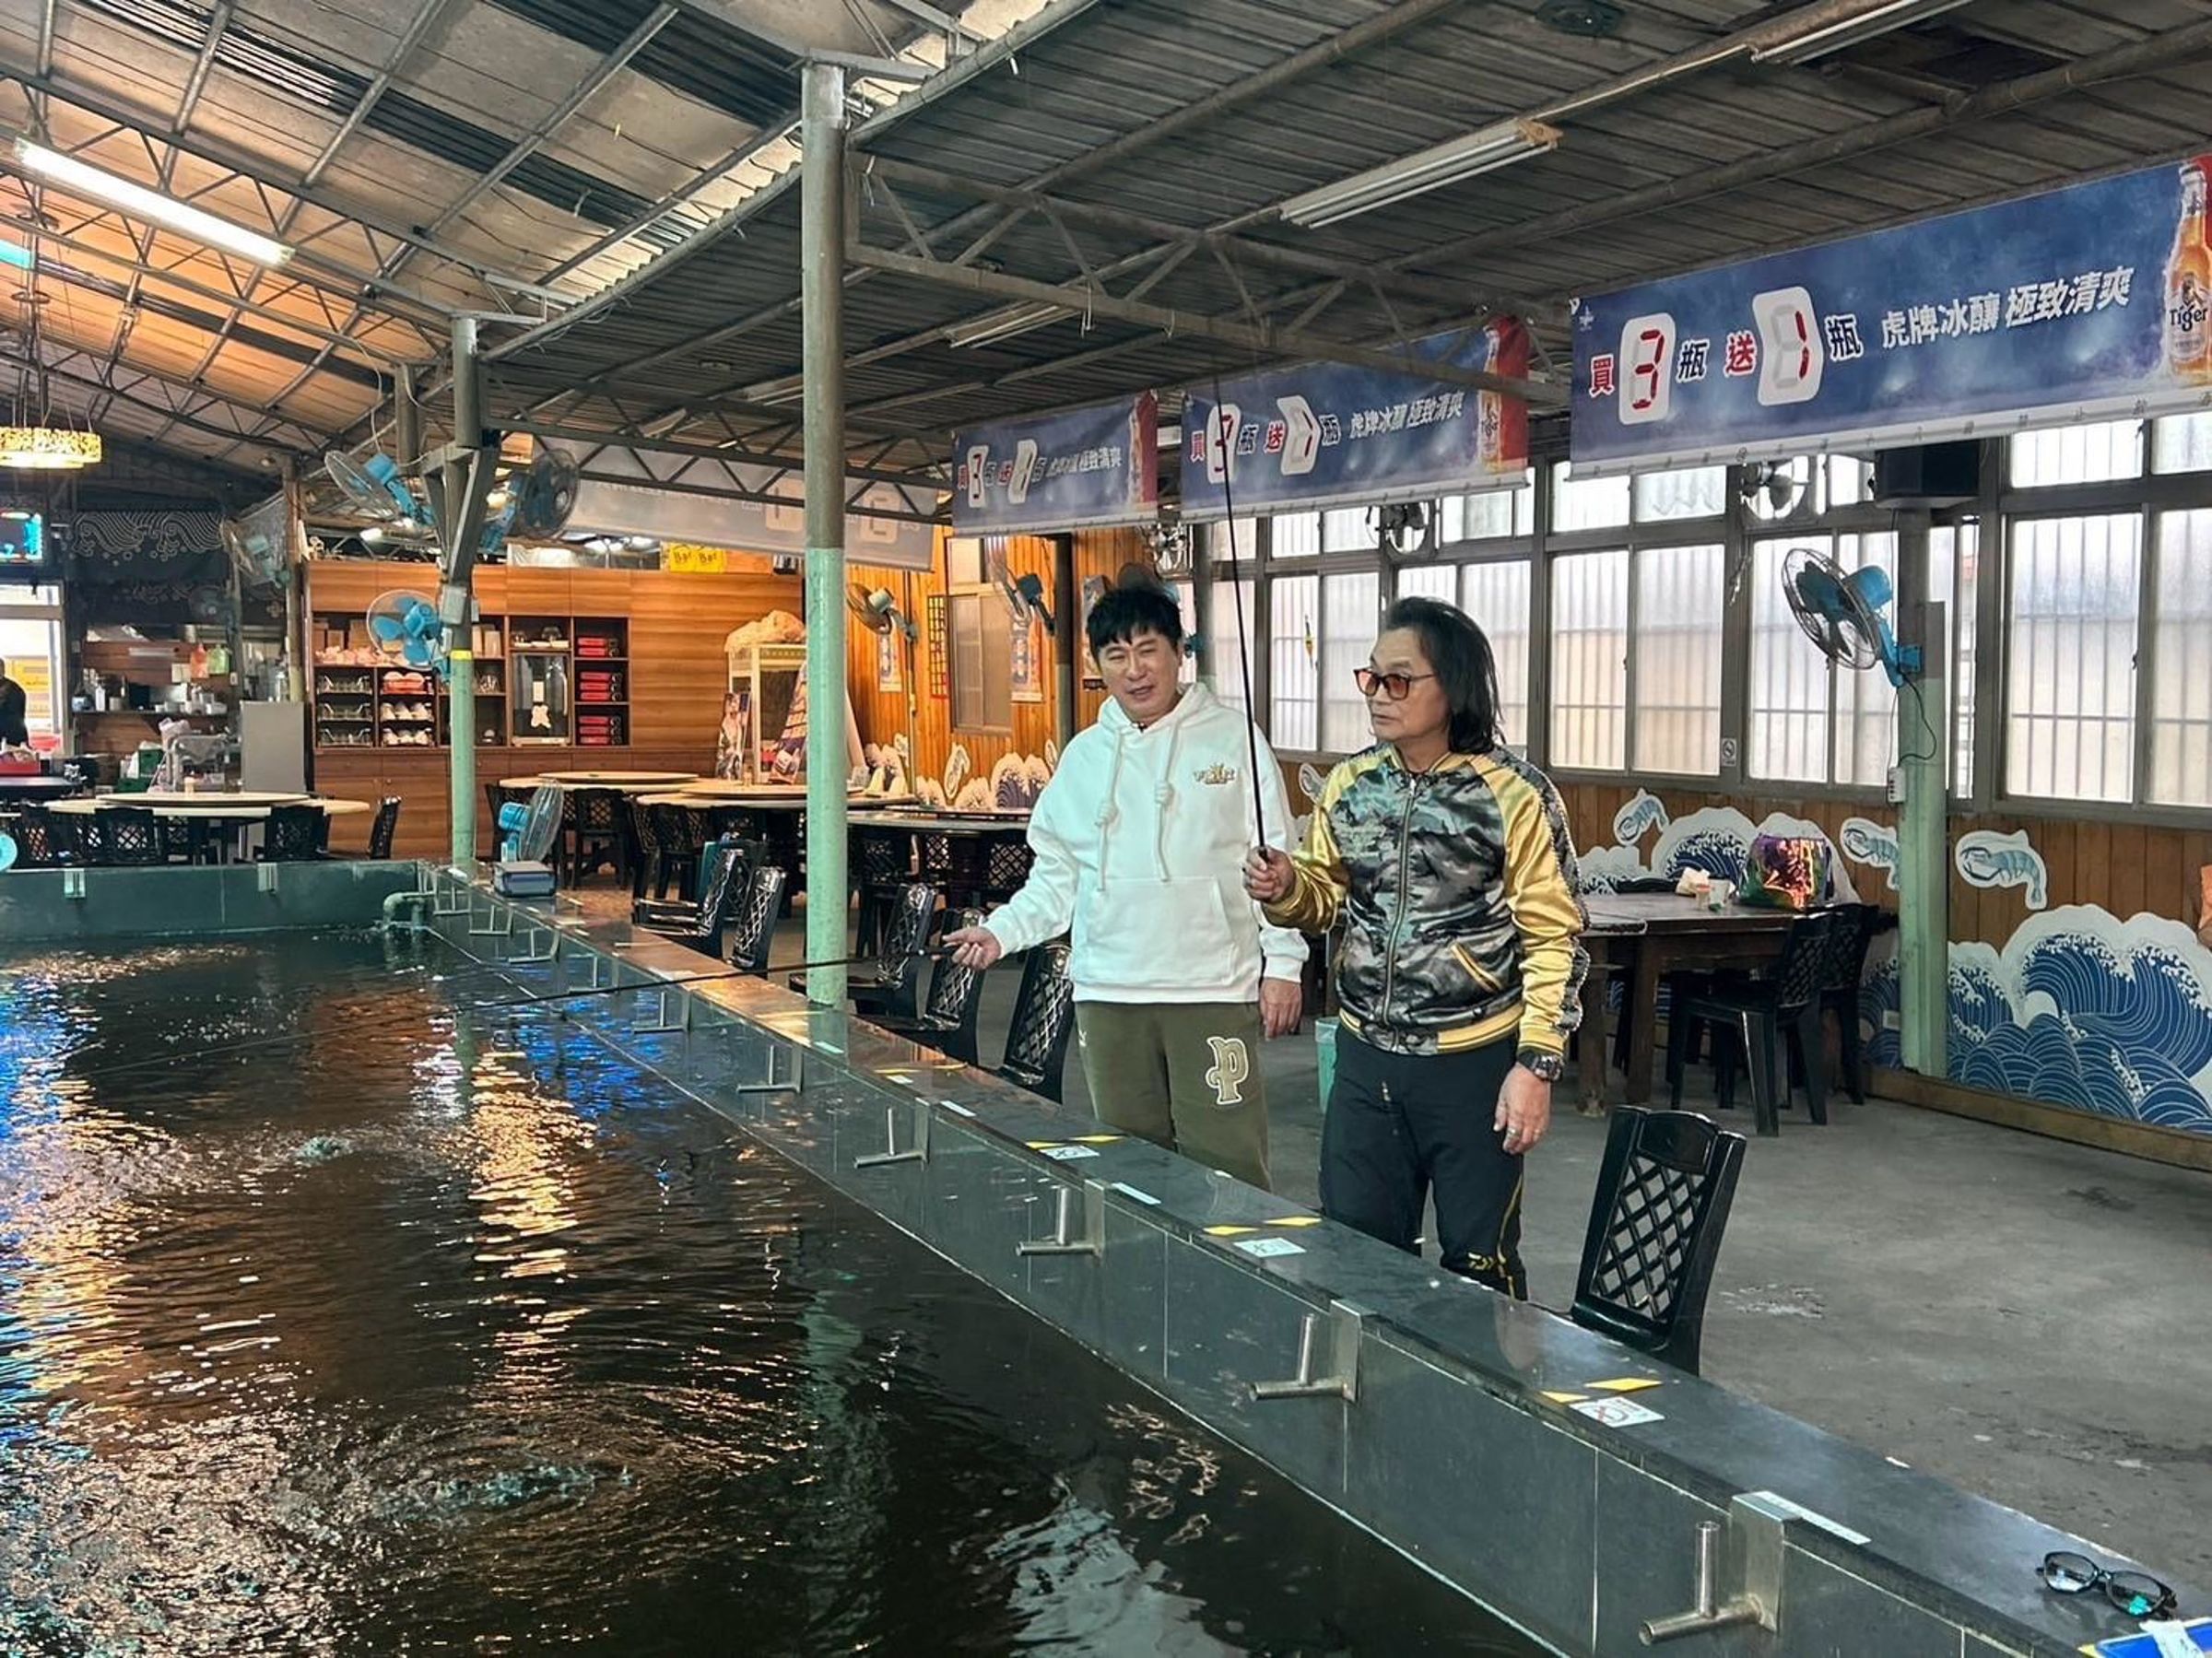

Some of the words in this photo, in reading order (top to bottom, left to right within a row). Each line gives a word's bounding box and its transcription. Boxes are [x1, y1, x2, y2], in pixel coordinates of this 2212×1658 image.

[2006, 265, 2135, 328] 極致清爽
[2170, 304, 2208, 332] Tiger
[1206, 1037, 1249, 1105] P
